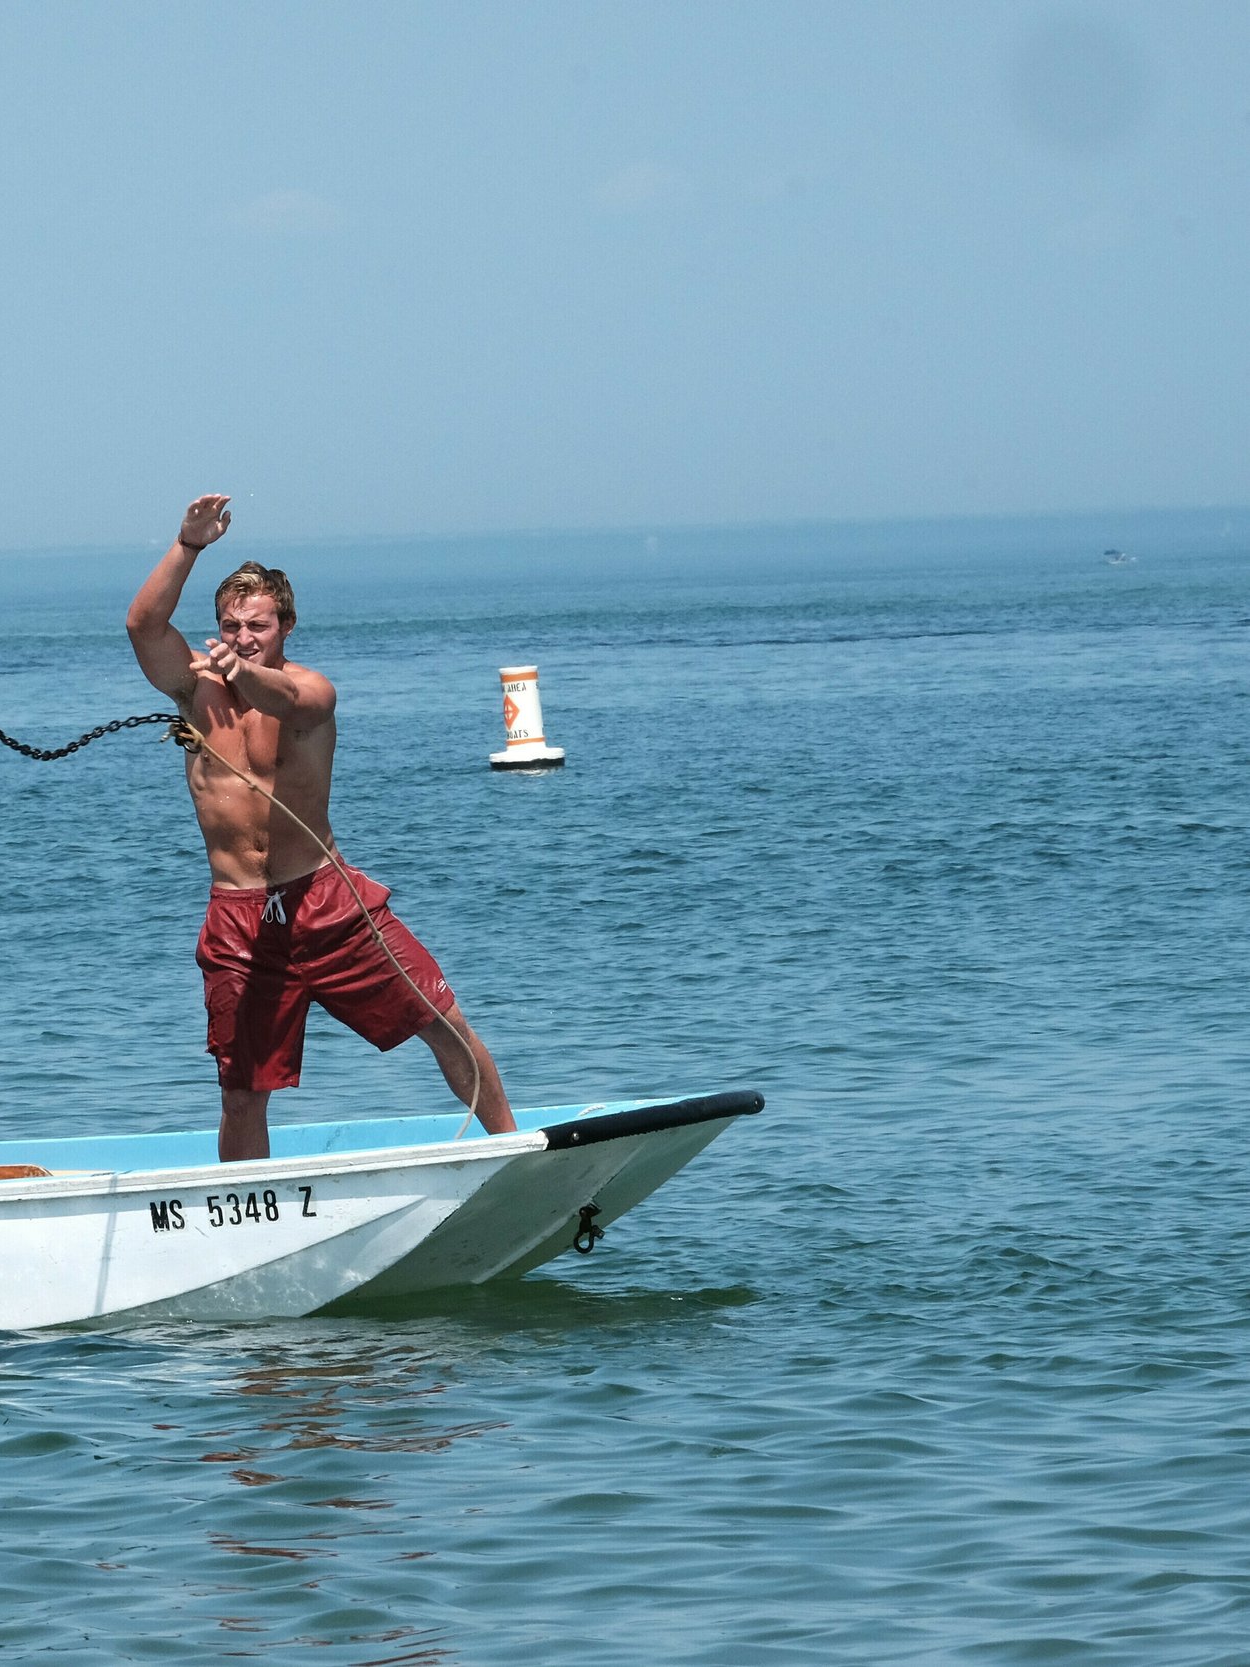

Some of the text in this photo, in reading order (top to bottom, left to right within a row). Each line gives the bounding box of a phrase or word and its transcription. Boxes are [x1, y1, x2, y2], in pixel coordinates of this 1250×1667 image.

[149, 1185, 317, 1232] MS 5348 Z
